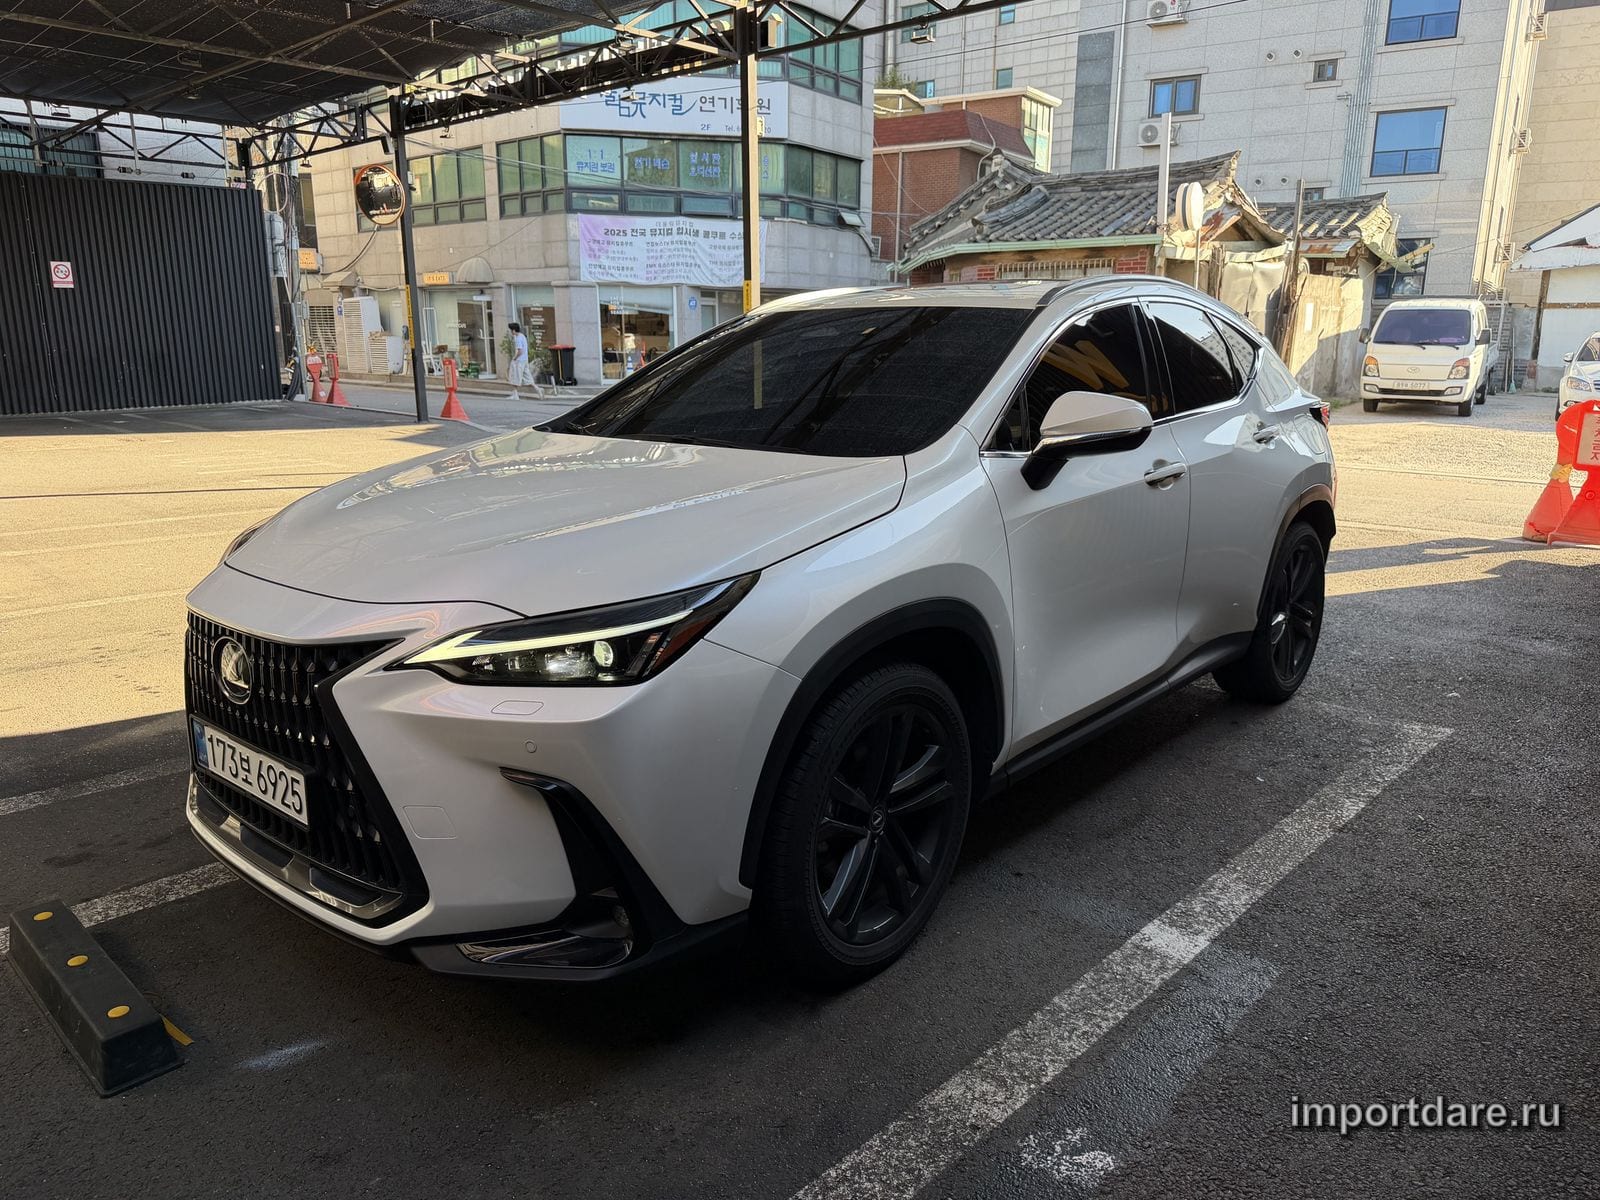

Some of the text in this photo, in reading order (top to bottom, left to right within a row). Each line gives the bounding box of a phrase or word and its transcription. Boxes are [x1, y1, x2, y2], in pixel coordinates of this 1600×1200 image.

[603, 228, 628, 237] 2025
[630, 227, 647, 237] 전국
[649, 226, 673, 237] 뮤지컬
